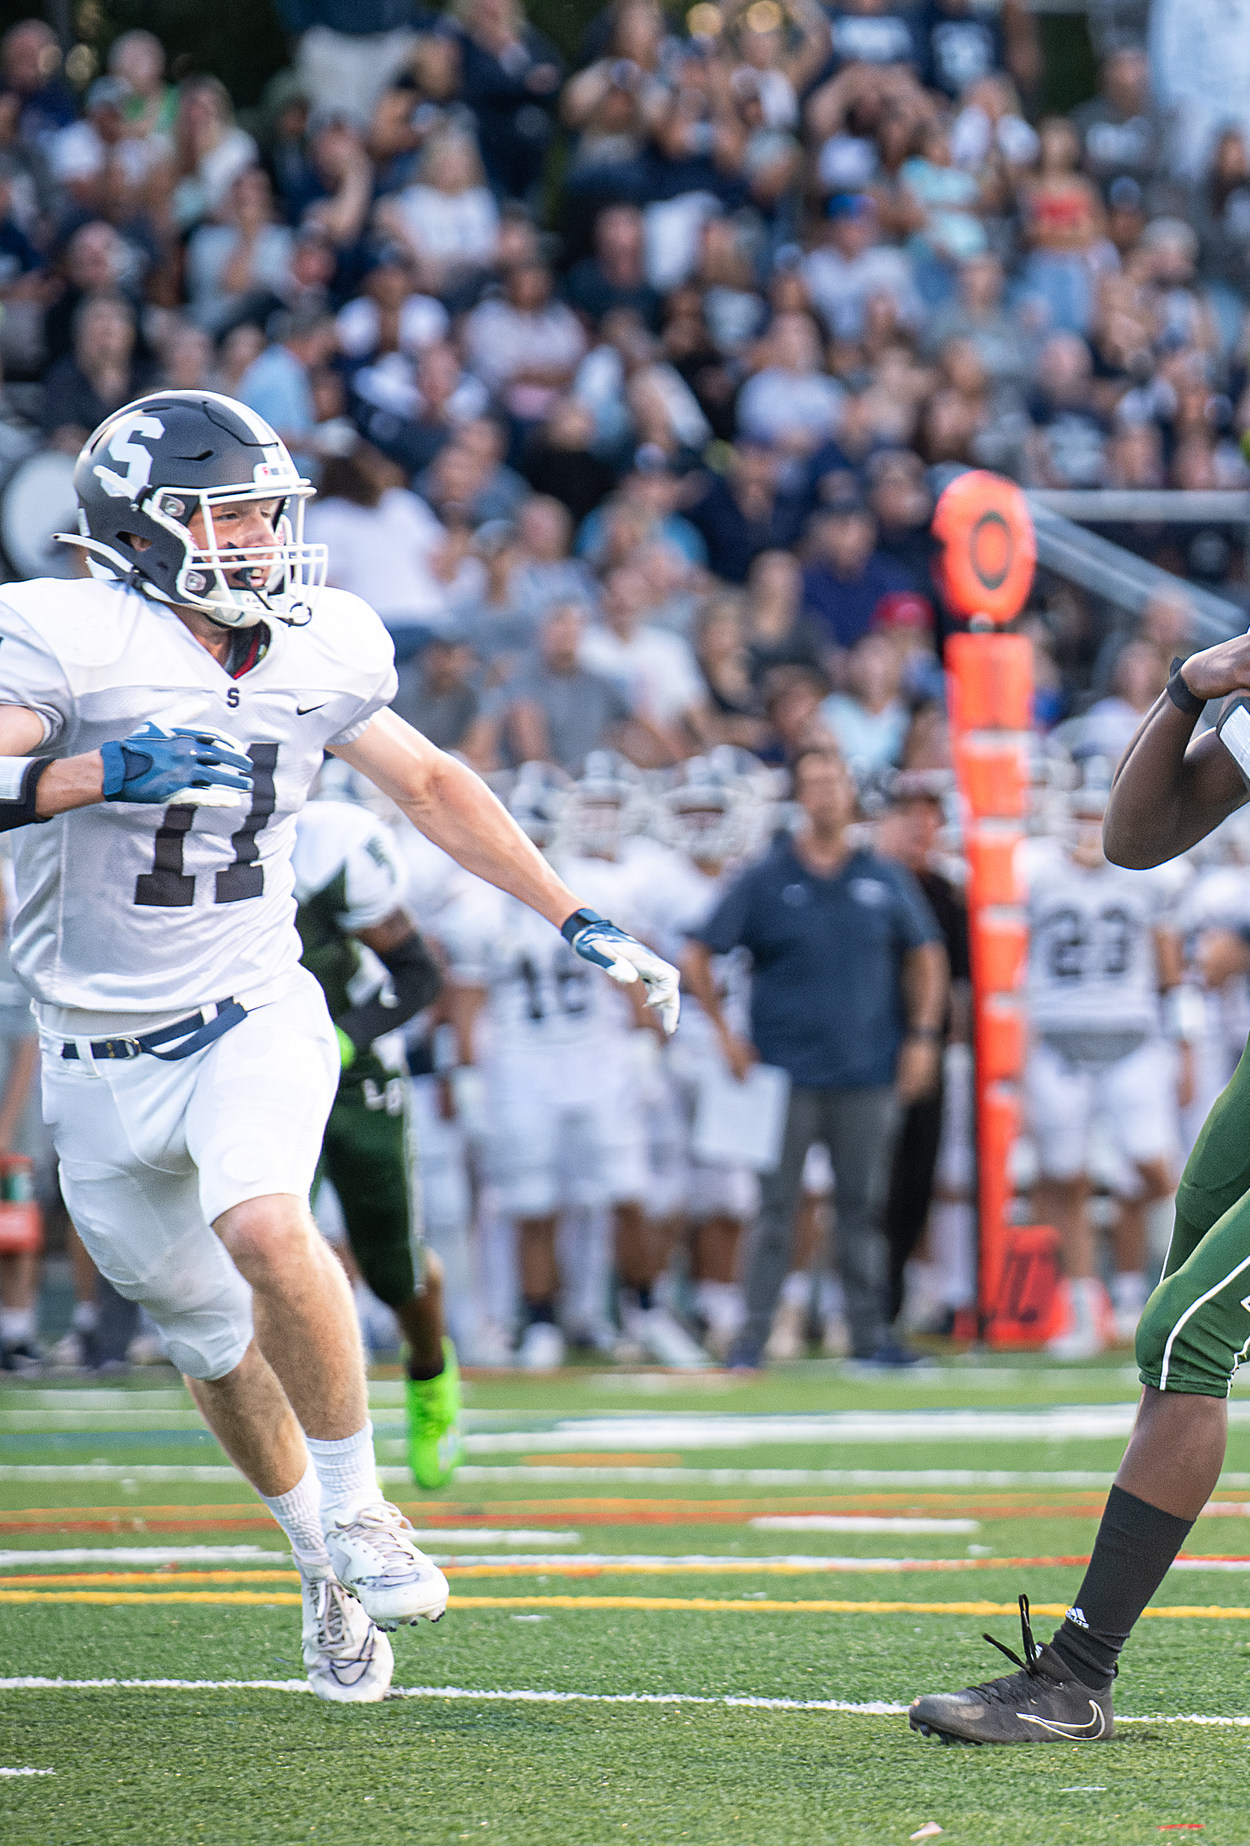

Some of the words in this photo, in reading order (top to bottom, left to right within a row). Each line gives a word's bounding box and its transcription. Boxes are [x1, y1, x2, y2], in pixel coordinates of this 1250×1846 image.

[101, 416, 166, 498] S
[226, 687, 241, 708] S
[133, 742, 279, 908] 11
